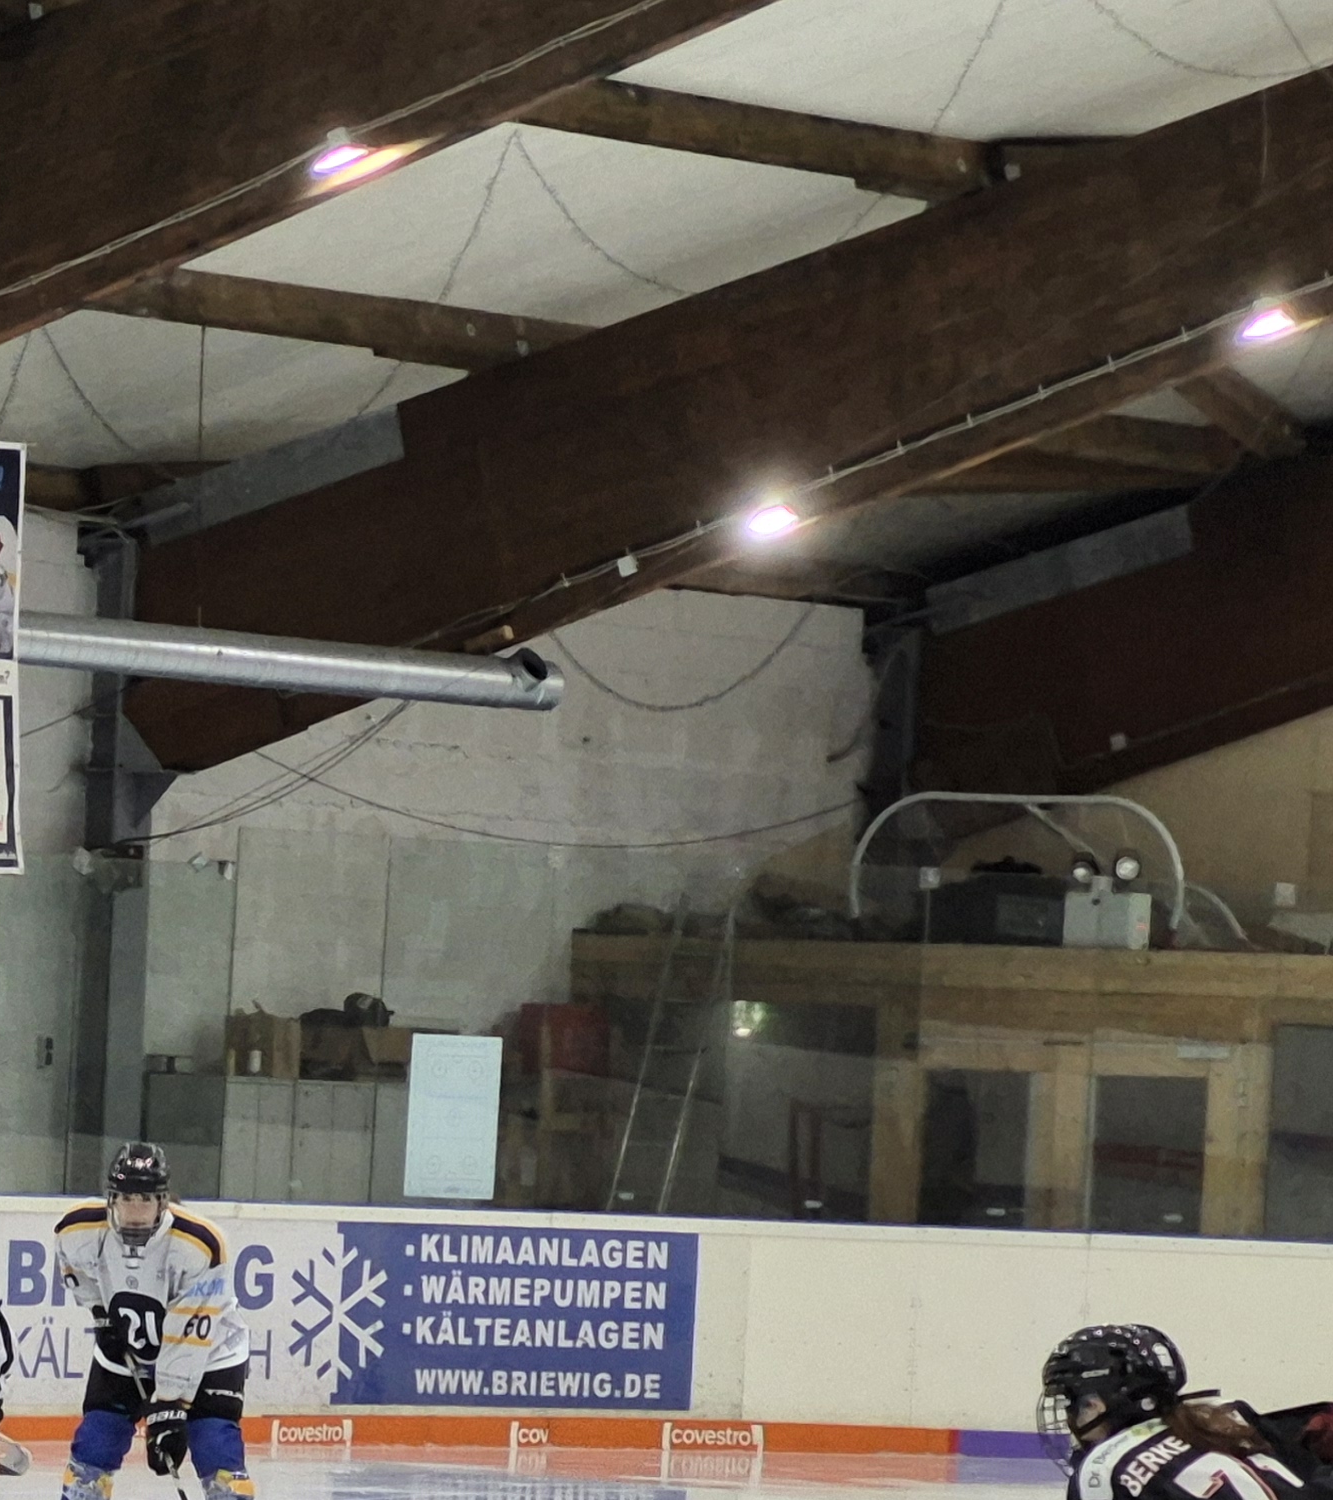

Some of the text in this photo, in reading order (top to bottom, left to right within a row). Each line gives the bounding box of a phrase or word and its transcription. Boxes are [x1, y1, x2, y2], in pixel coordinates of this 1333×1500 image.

[420, 1233, 669, 1270] KLIMAANLAGEN
[420, 1270, 667, 1310] WÄRMEPUMPEN
[118, 1307, 161, 1350] 21
[183, 1312, 212, 1341] 60
[415, 1311, 665, 1350] KÄLTEANLAGEN
[414, 1368, 662, 1399] WWW.BRIEWIG.DE
[278, 1424, 343, 1443] covestro
[671, 1427, 751, 1447] covestro
[1119, 1435, 1192, 1498] BERKE
